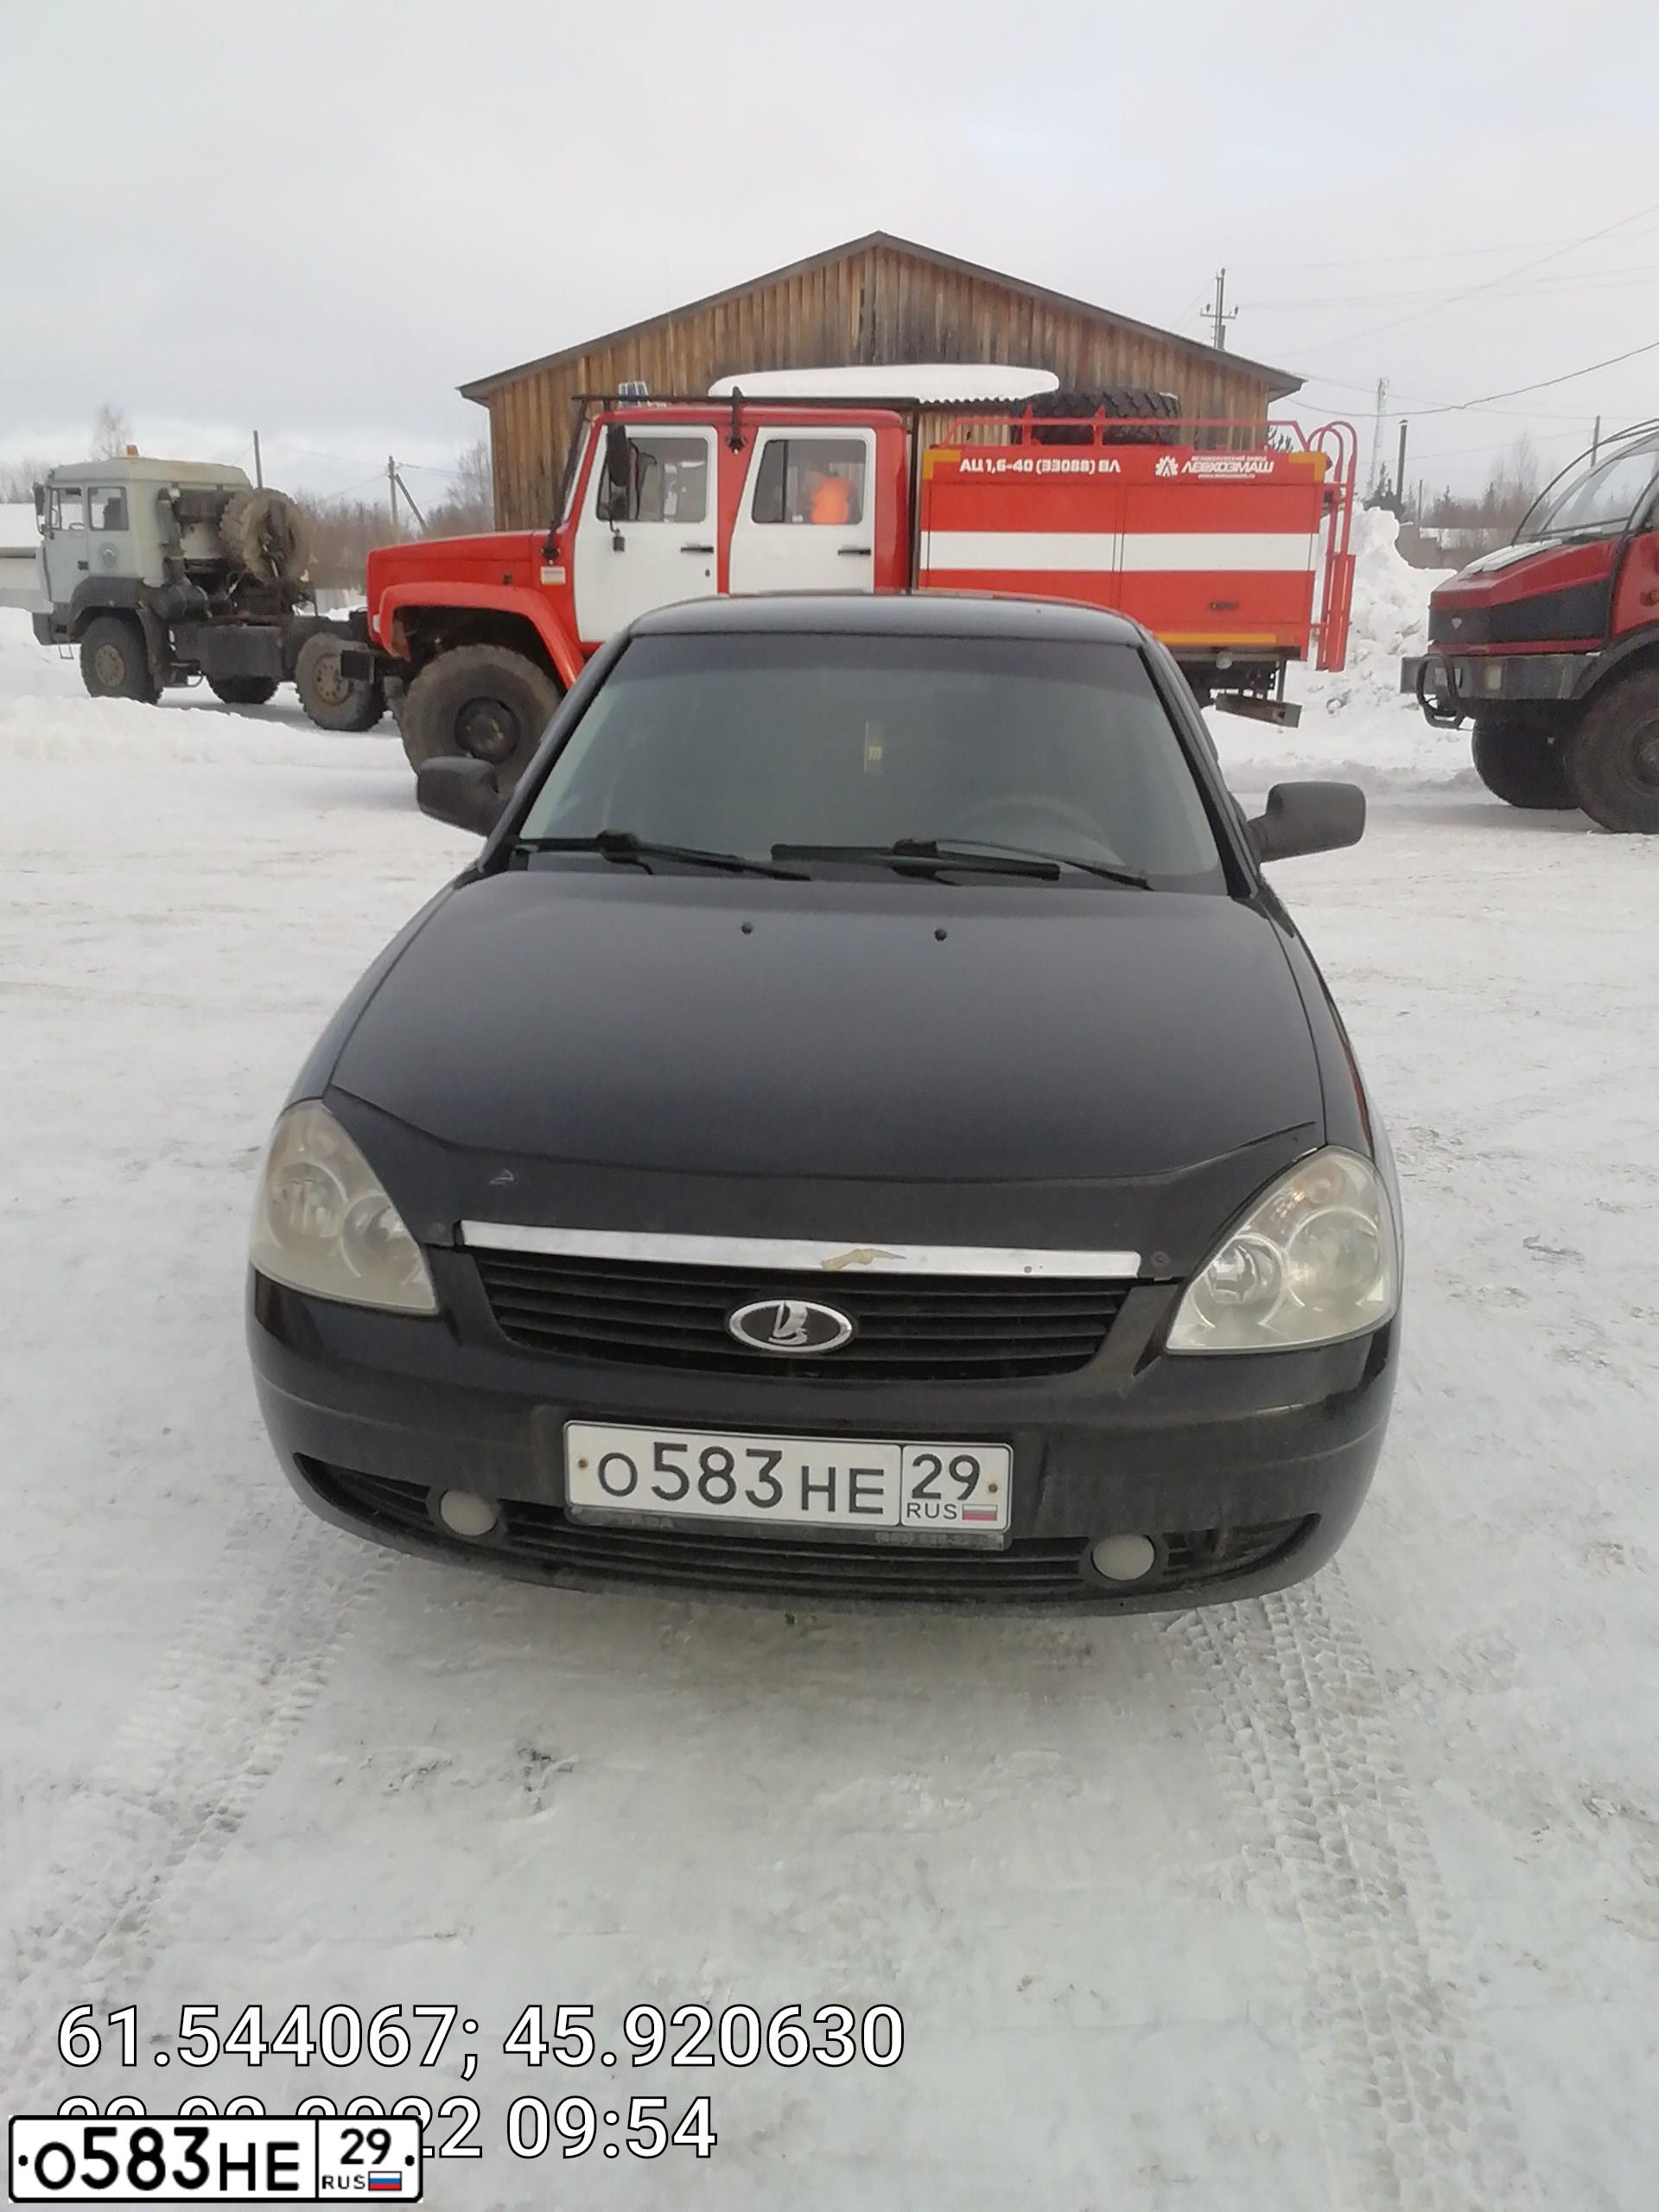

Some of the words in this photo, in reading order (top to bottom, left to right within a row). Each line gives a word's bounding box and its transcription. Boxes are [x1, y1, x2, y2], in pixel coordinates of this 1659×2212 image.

[959, 459, 984, 472] АЦ
[986, 459, 1033, 474] 1,6-40
[912, 1453, 981, 1501] 29
[906, 1502, 957, 1520] RUS
